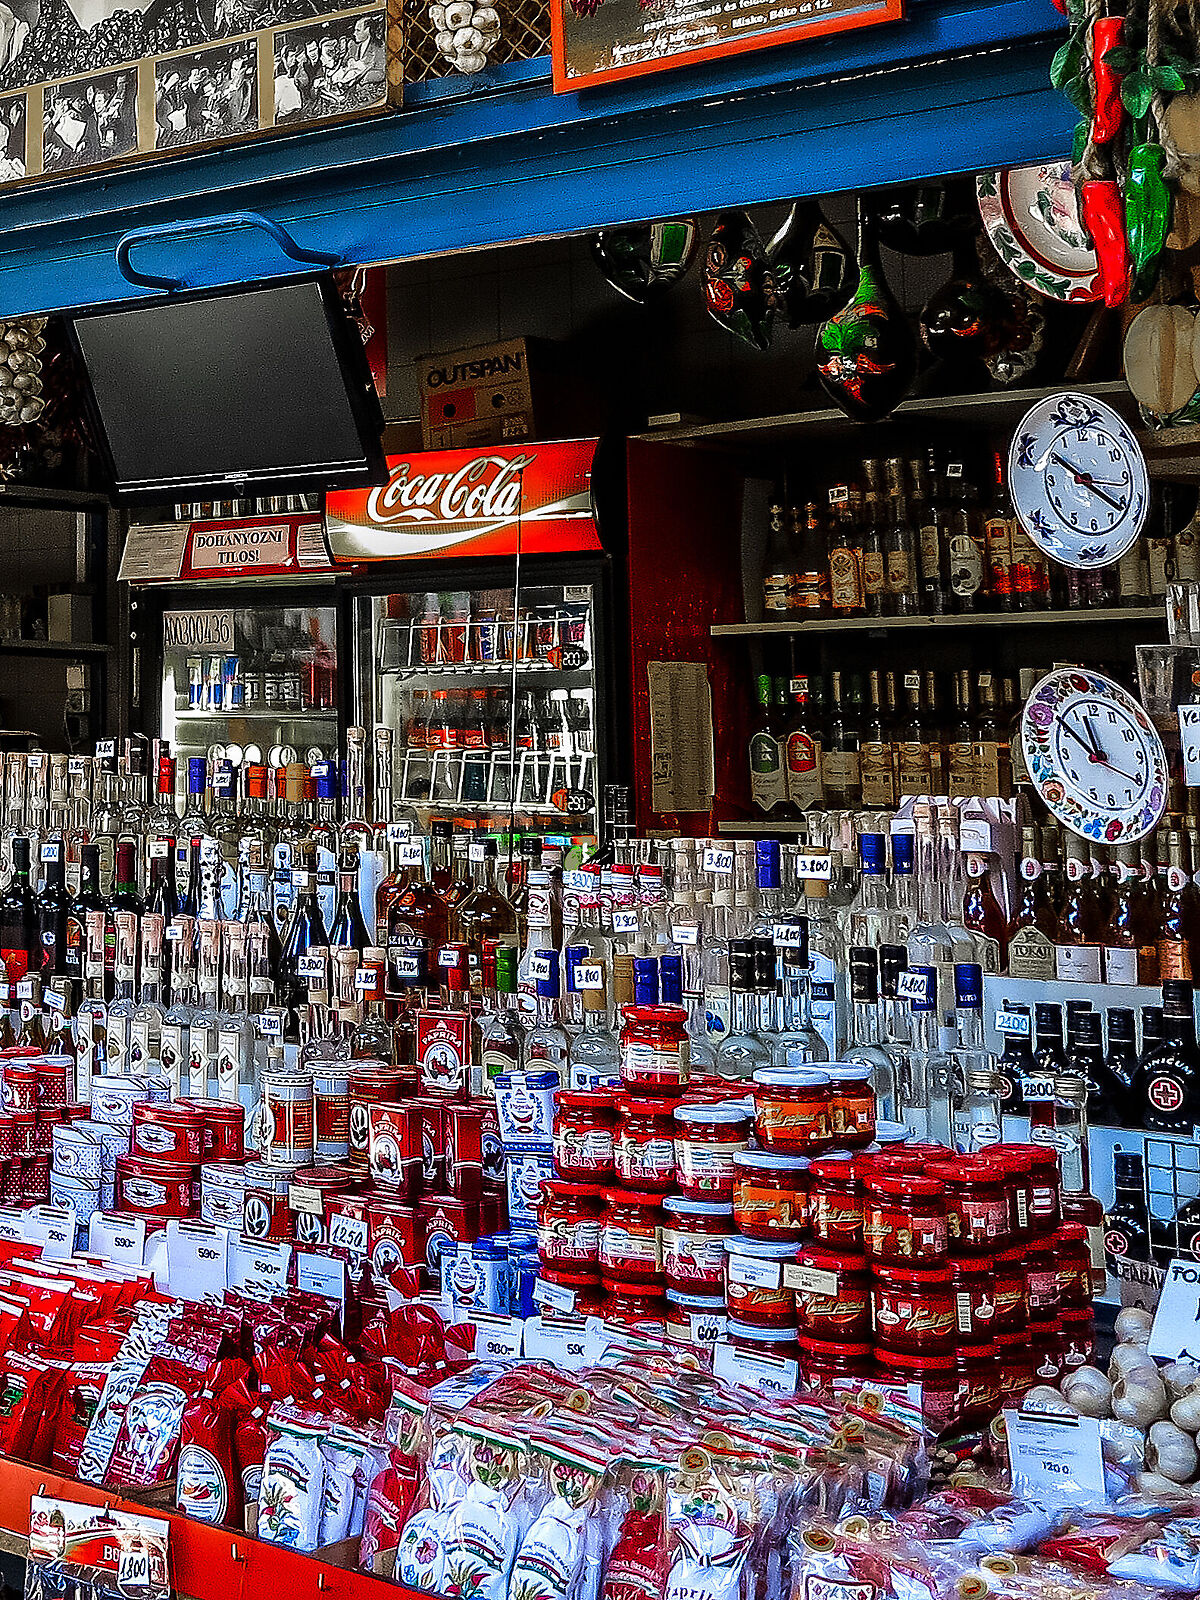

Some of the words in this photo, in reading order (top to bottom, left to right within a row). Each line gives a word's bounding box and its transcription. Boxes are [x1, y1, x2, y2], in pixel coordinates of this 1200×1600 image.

[731, 13, 768, 30] Miske,
[769, 7, 797, 22] Béke
[799, 4, 813, 16] út
[814, 1, 833, 12] 12.
[427, 352, 525, 388] OUTSPAN
[1061, 437, 1068, 448] 1
[1076, 429, 1089, 443] 12
[1109, 448, 1121, 462] 10
[1048, 474, 1056, 487] 3
[368, 454, 537, 523] Coca-Cola
[1070, 512, 1078, 525] 5
[1108, 513, 1116, 525] 7
[1091, 519, 1098, 532] 6
[196, 530, 283, 550] DOHÁNYOZNI
[217, 549, 261, 565] TILOS!
[1072, 710, 1080, 722] 1
[1087, 704, 1100, 717] 12
[1121, 729, 1135, 742] 10
[1136, 751, 1144, 765] 9
[1089, 788, 1098, 801] 5
[1107, 794, 1116, 807] 6
[1125, 789, 1132, 802] 7
[388, 935, 424, 948] SZILVA
[998, 1014, 1028, 1031] 2400
[421, 1028, 462, 1049] PAPRIKA
[1143, 1057, 1195, 1076] UNICUM
[1023, 1082, 1055, 1096] 2800
